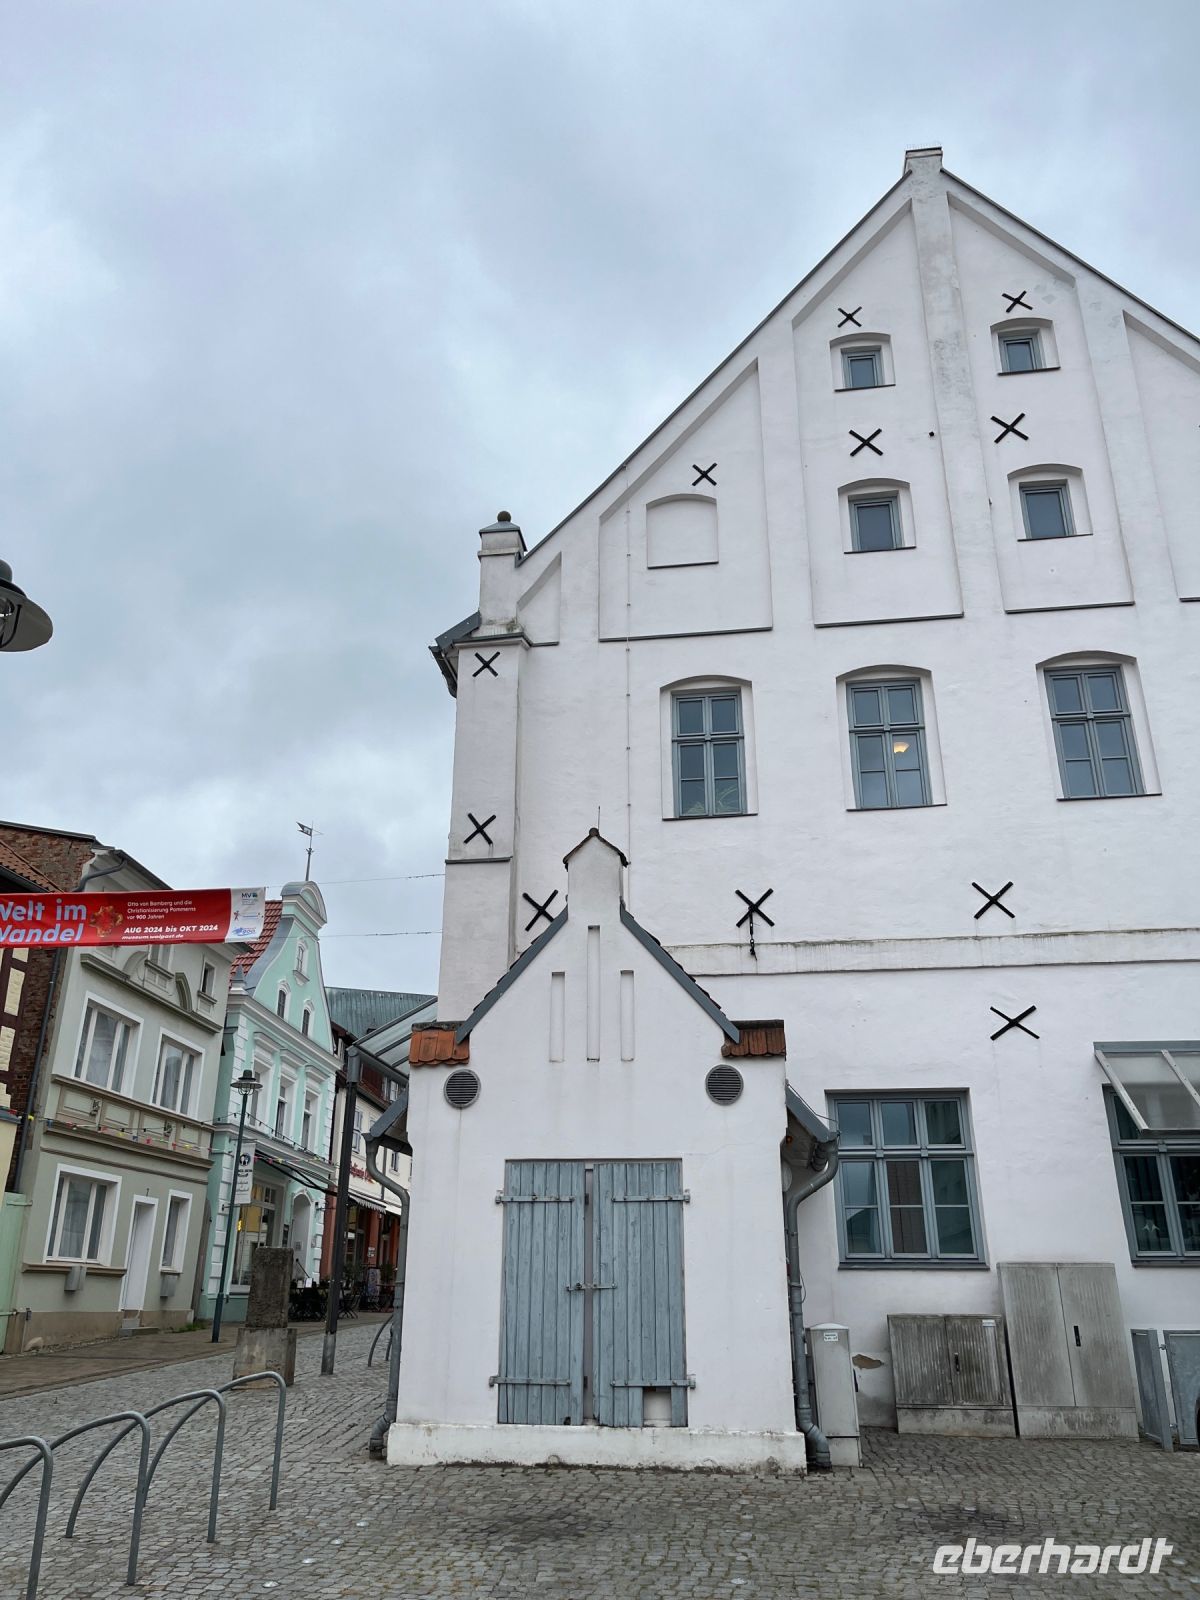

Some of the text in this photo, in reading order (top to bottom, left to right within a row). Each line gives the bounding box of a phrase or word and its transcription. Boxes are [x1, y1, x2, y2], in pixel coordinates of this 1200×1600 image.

[56, 898, 87, 921] im
[124, 926, 142, 934] AUG
[165, 925, 177, 933] bis
[198, 924, 219, 932] 2024
